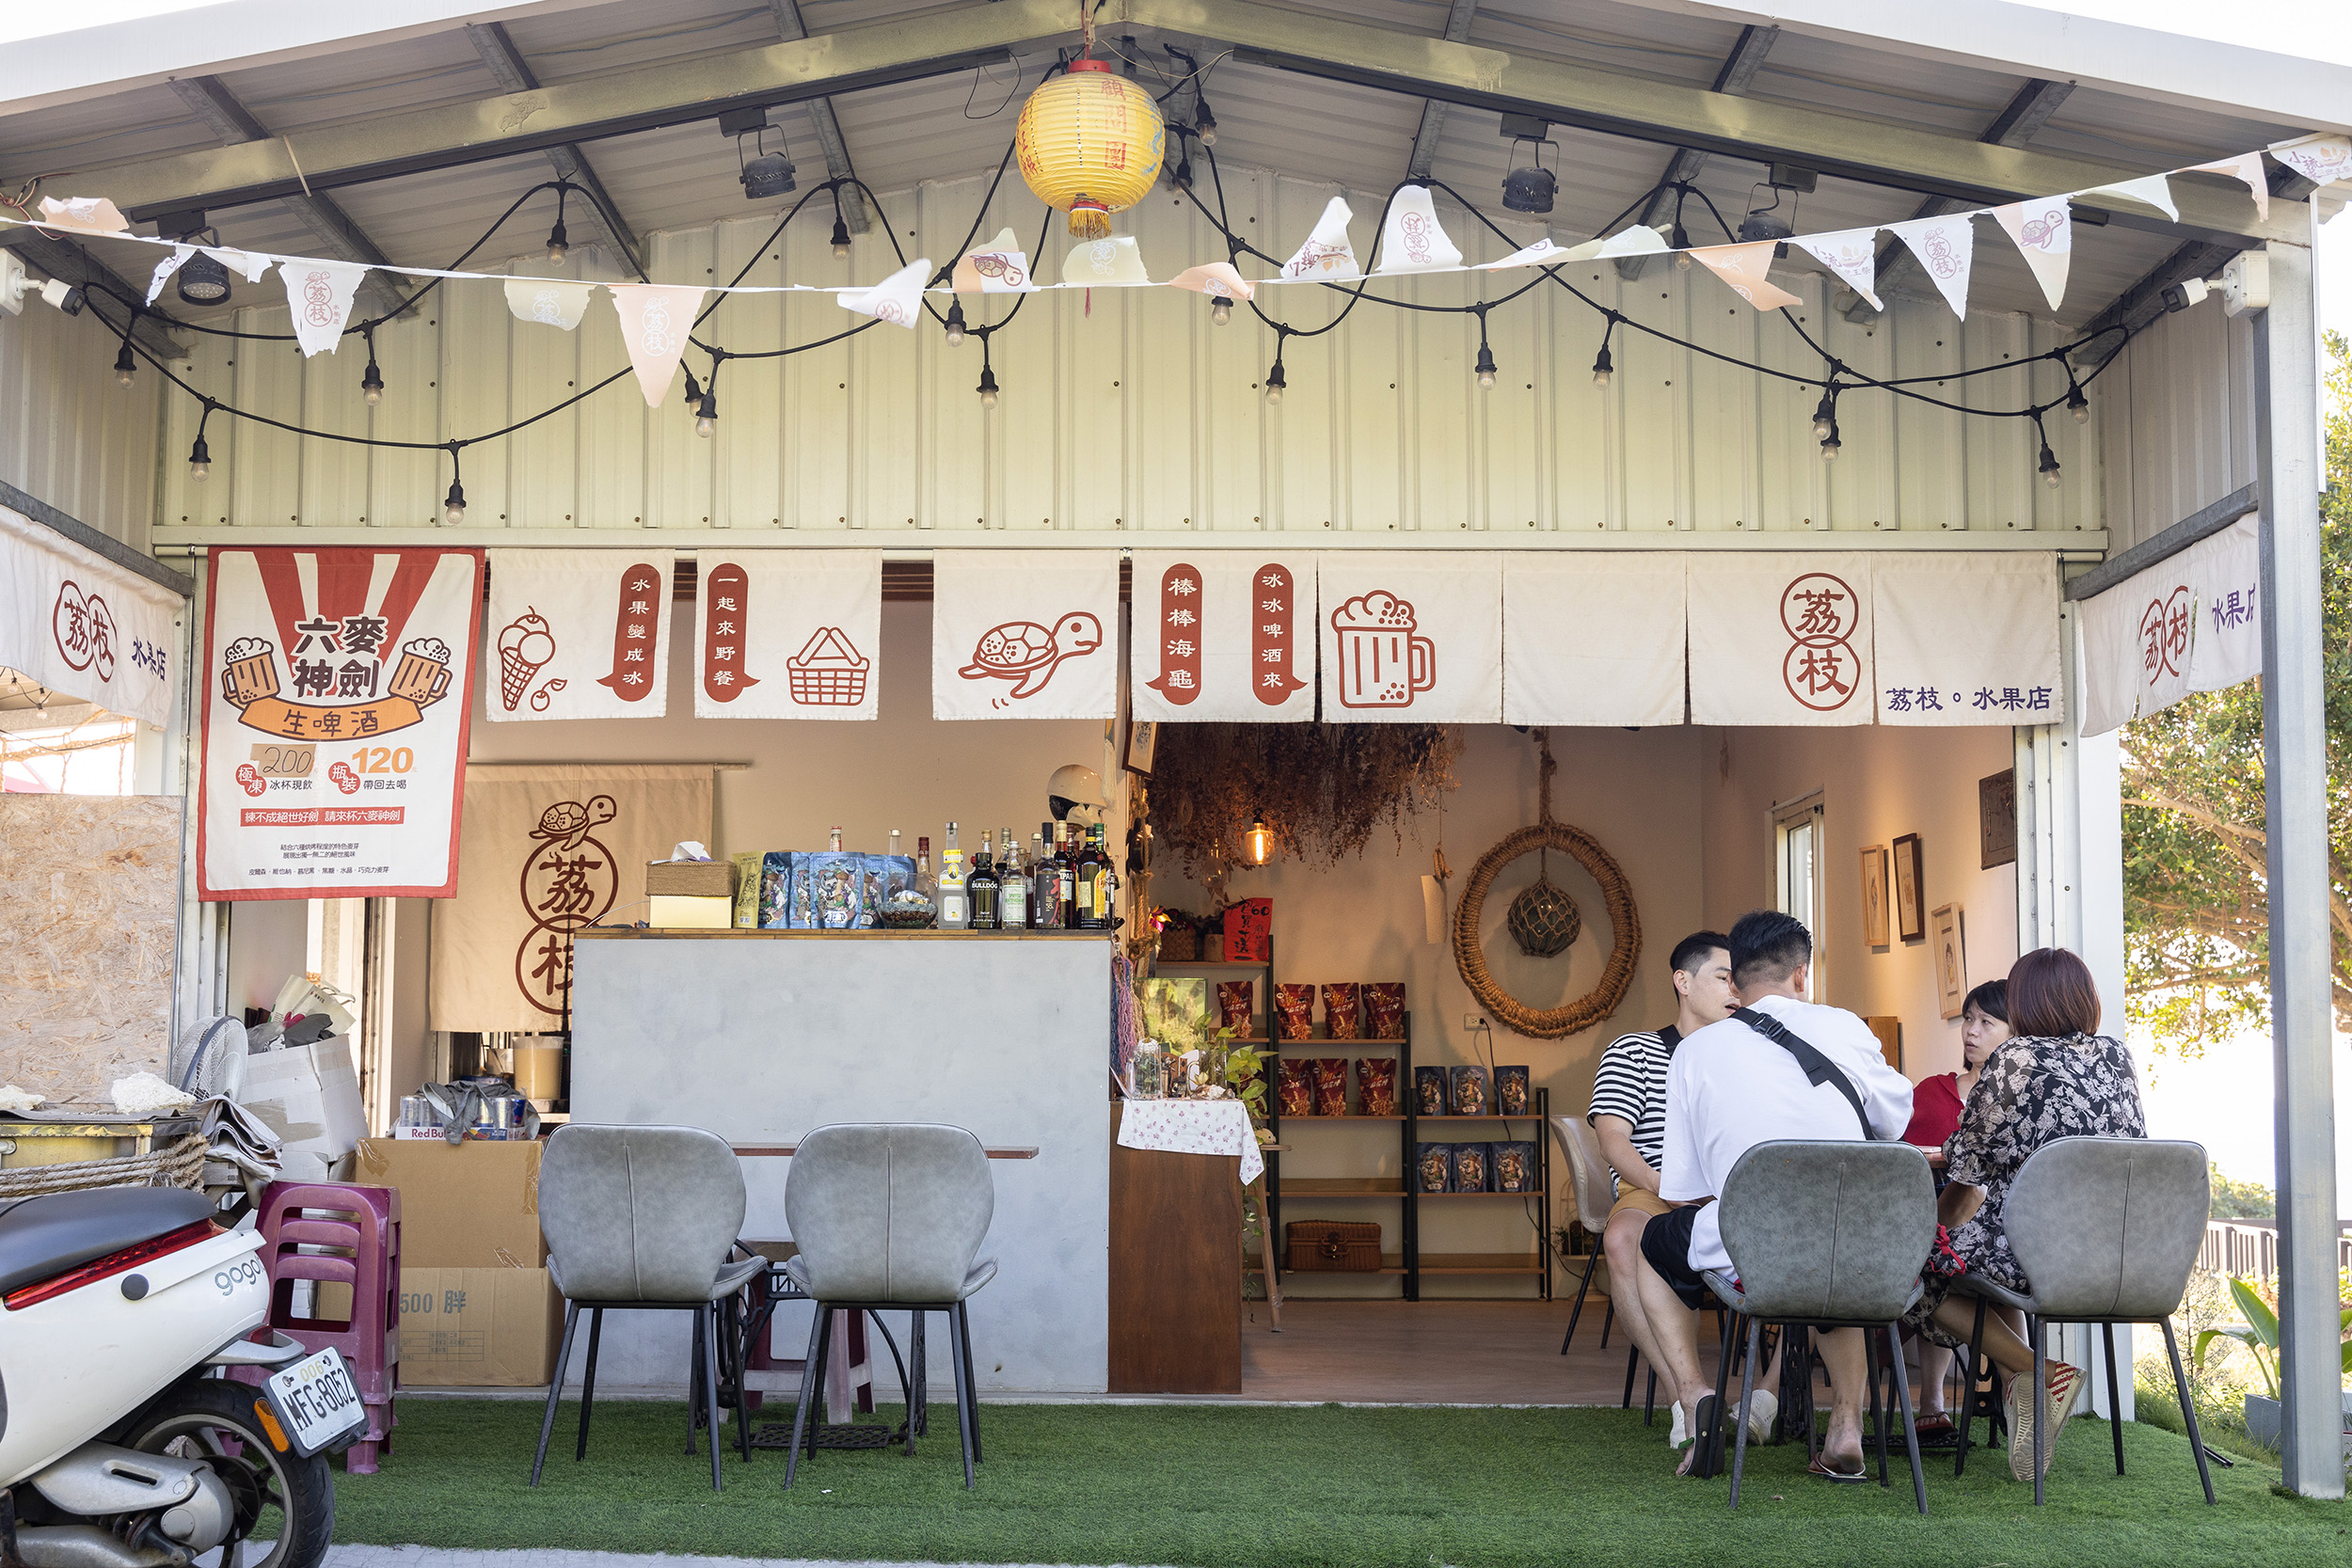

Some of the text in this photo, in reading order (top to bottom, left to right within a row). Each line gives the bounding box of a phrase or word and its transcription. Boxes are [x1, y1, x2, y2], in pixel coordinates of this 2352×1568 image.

[1929, 241, 1954, 275] 荔枝
[309, 285, 328, 322] 荔枝
[646, 312, 666, 351] 荔枝
[64, 598, 115, 667] 荔枝
[295, 616, 387, 655] 六麥
[621, 578, 651, 687] 水果變成冰
[712, 577, 739, 688] 一起來野餐
[1262, 573, 1284, 689] 冰冰啤酒來
[1792, 588, 1851, 696] 荔枝
[293, 658, 380, 698] 神劍
[282, 708, 378, 737] 生啤酒
[262, 746, 312, 774] 200
[352, 747, 414, 774] 120
[269, 780, 313, 791] 冰杯現飲
[332, 765, 358, 792] 瓶裝
[362, 779, 407, 790] 帶回去喝
[325, 810, 401, 823] 請來杯六麥神劍
[971, 879, 998, 889] BULLDOG
[411, 1128, 447, 1138] Red Bul
[400, 1290, 467, 1314] 500 胖
[282, 1368, 356, 1432] MFG-8052
